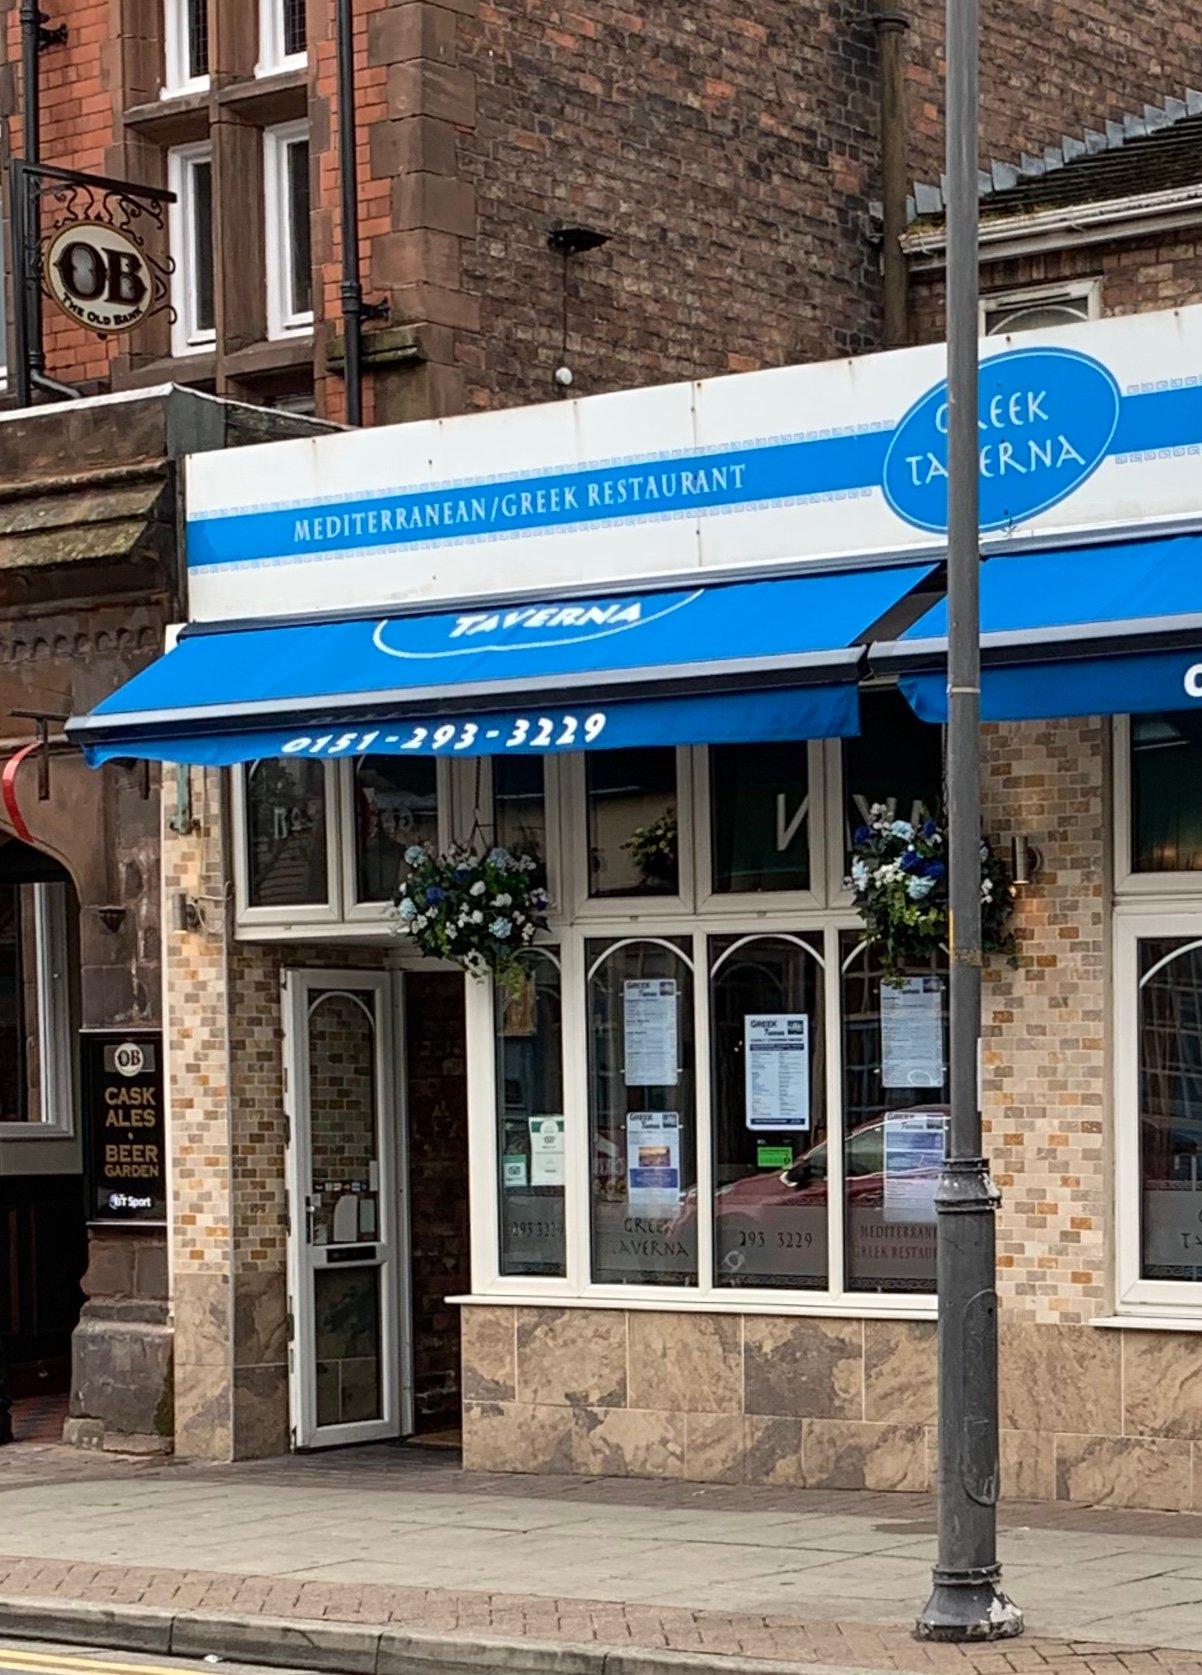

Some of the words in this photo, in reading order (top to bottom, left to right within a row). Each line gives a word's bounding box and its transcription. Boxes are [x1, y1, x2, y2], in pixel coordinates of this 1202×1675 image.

[53, 241, 148, 306] OB
[87, 311, 111, 325] OLD
[112, 307, 142, 325] BANK
[935, 390, 1049, 434] GEEK
[905, 435, 1086, 486] TAERNA
[293, 484, 581, 543] MEDITERRANEAN/GREEK
[587, 462, 746, 507] RESTAURANT
[449, 602, 642, 640] TAVERNA
[117, 1050, 141, 1068] OB
[104, 1086, 156, 1106] CASK
[105, 1109, 156, 1128] ALES
[105, 1144, 158, 1163] BEER
[104, 1165, 159, 1178] GARDEN
[128, 1196, 151, 1208] Sport
[740, 1230, 765, 1247] 293
[778, 1232, 813, 1248] 3229
